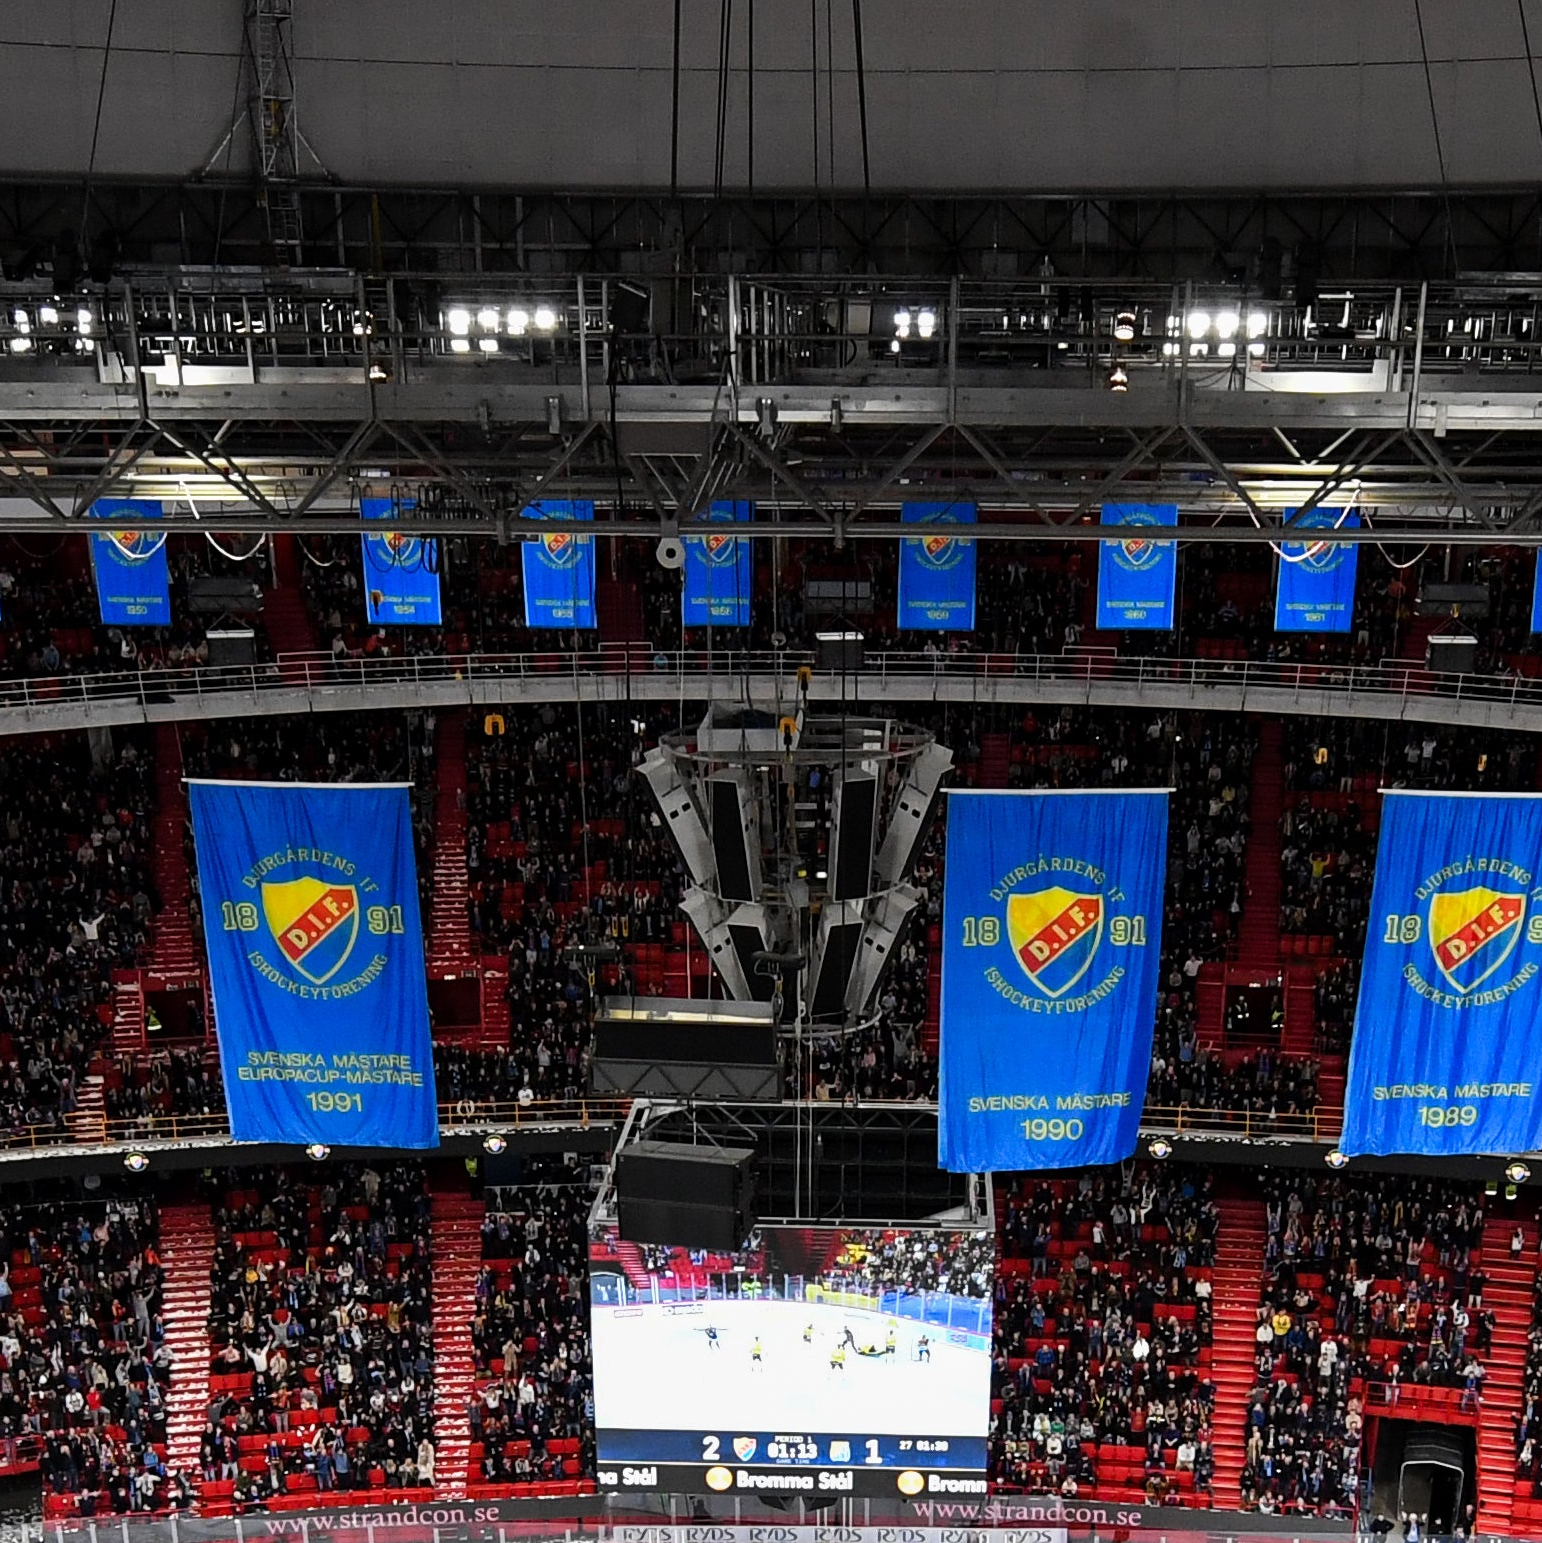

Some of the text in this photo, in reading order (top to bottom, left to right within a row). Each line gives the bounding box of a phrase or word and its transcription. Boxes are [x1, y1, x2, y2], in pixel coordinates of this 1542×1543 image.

[222, 901, 405, 934] 18 91
[962, 916, 1146, 947] 18 91
[1384, 914, 1421, 944] 18
[248, 1051, 325, 1067] SVENSKA
[1373, 1081, 1532, 1100] SVENSKA MÄSTARE
[306, 1091, 363, 1113] 1991
[969, 1092, 1132, 1112] SVENSKA MÄSTARE
[1417, 1106, 1477, 1128] 1989
[1020, 1119, 1084, 1141] 1990
[702, 1436, 720, 1461] 2
[767, 1443, 818, 1459] 01:13
[865, 1440, 882, 1463] 1
[621, 1467, 658, 1486] Stål
[737, 1470, 854, 1491] Bromma Stål
[265, 1504, 499, 1535] www.strandcon.se
[912, 1502, 1143, 1528] www.strandcon.se
[686, 1528, 735, 1543] RYDS
[749, 1528, 798, 1543] RYDS
[876, 1528, 925, 1543] RYDS
